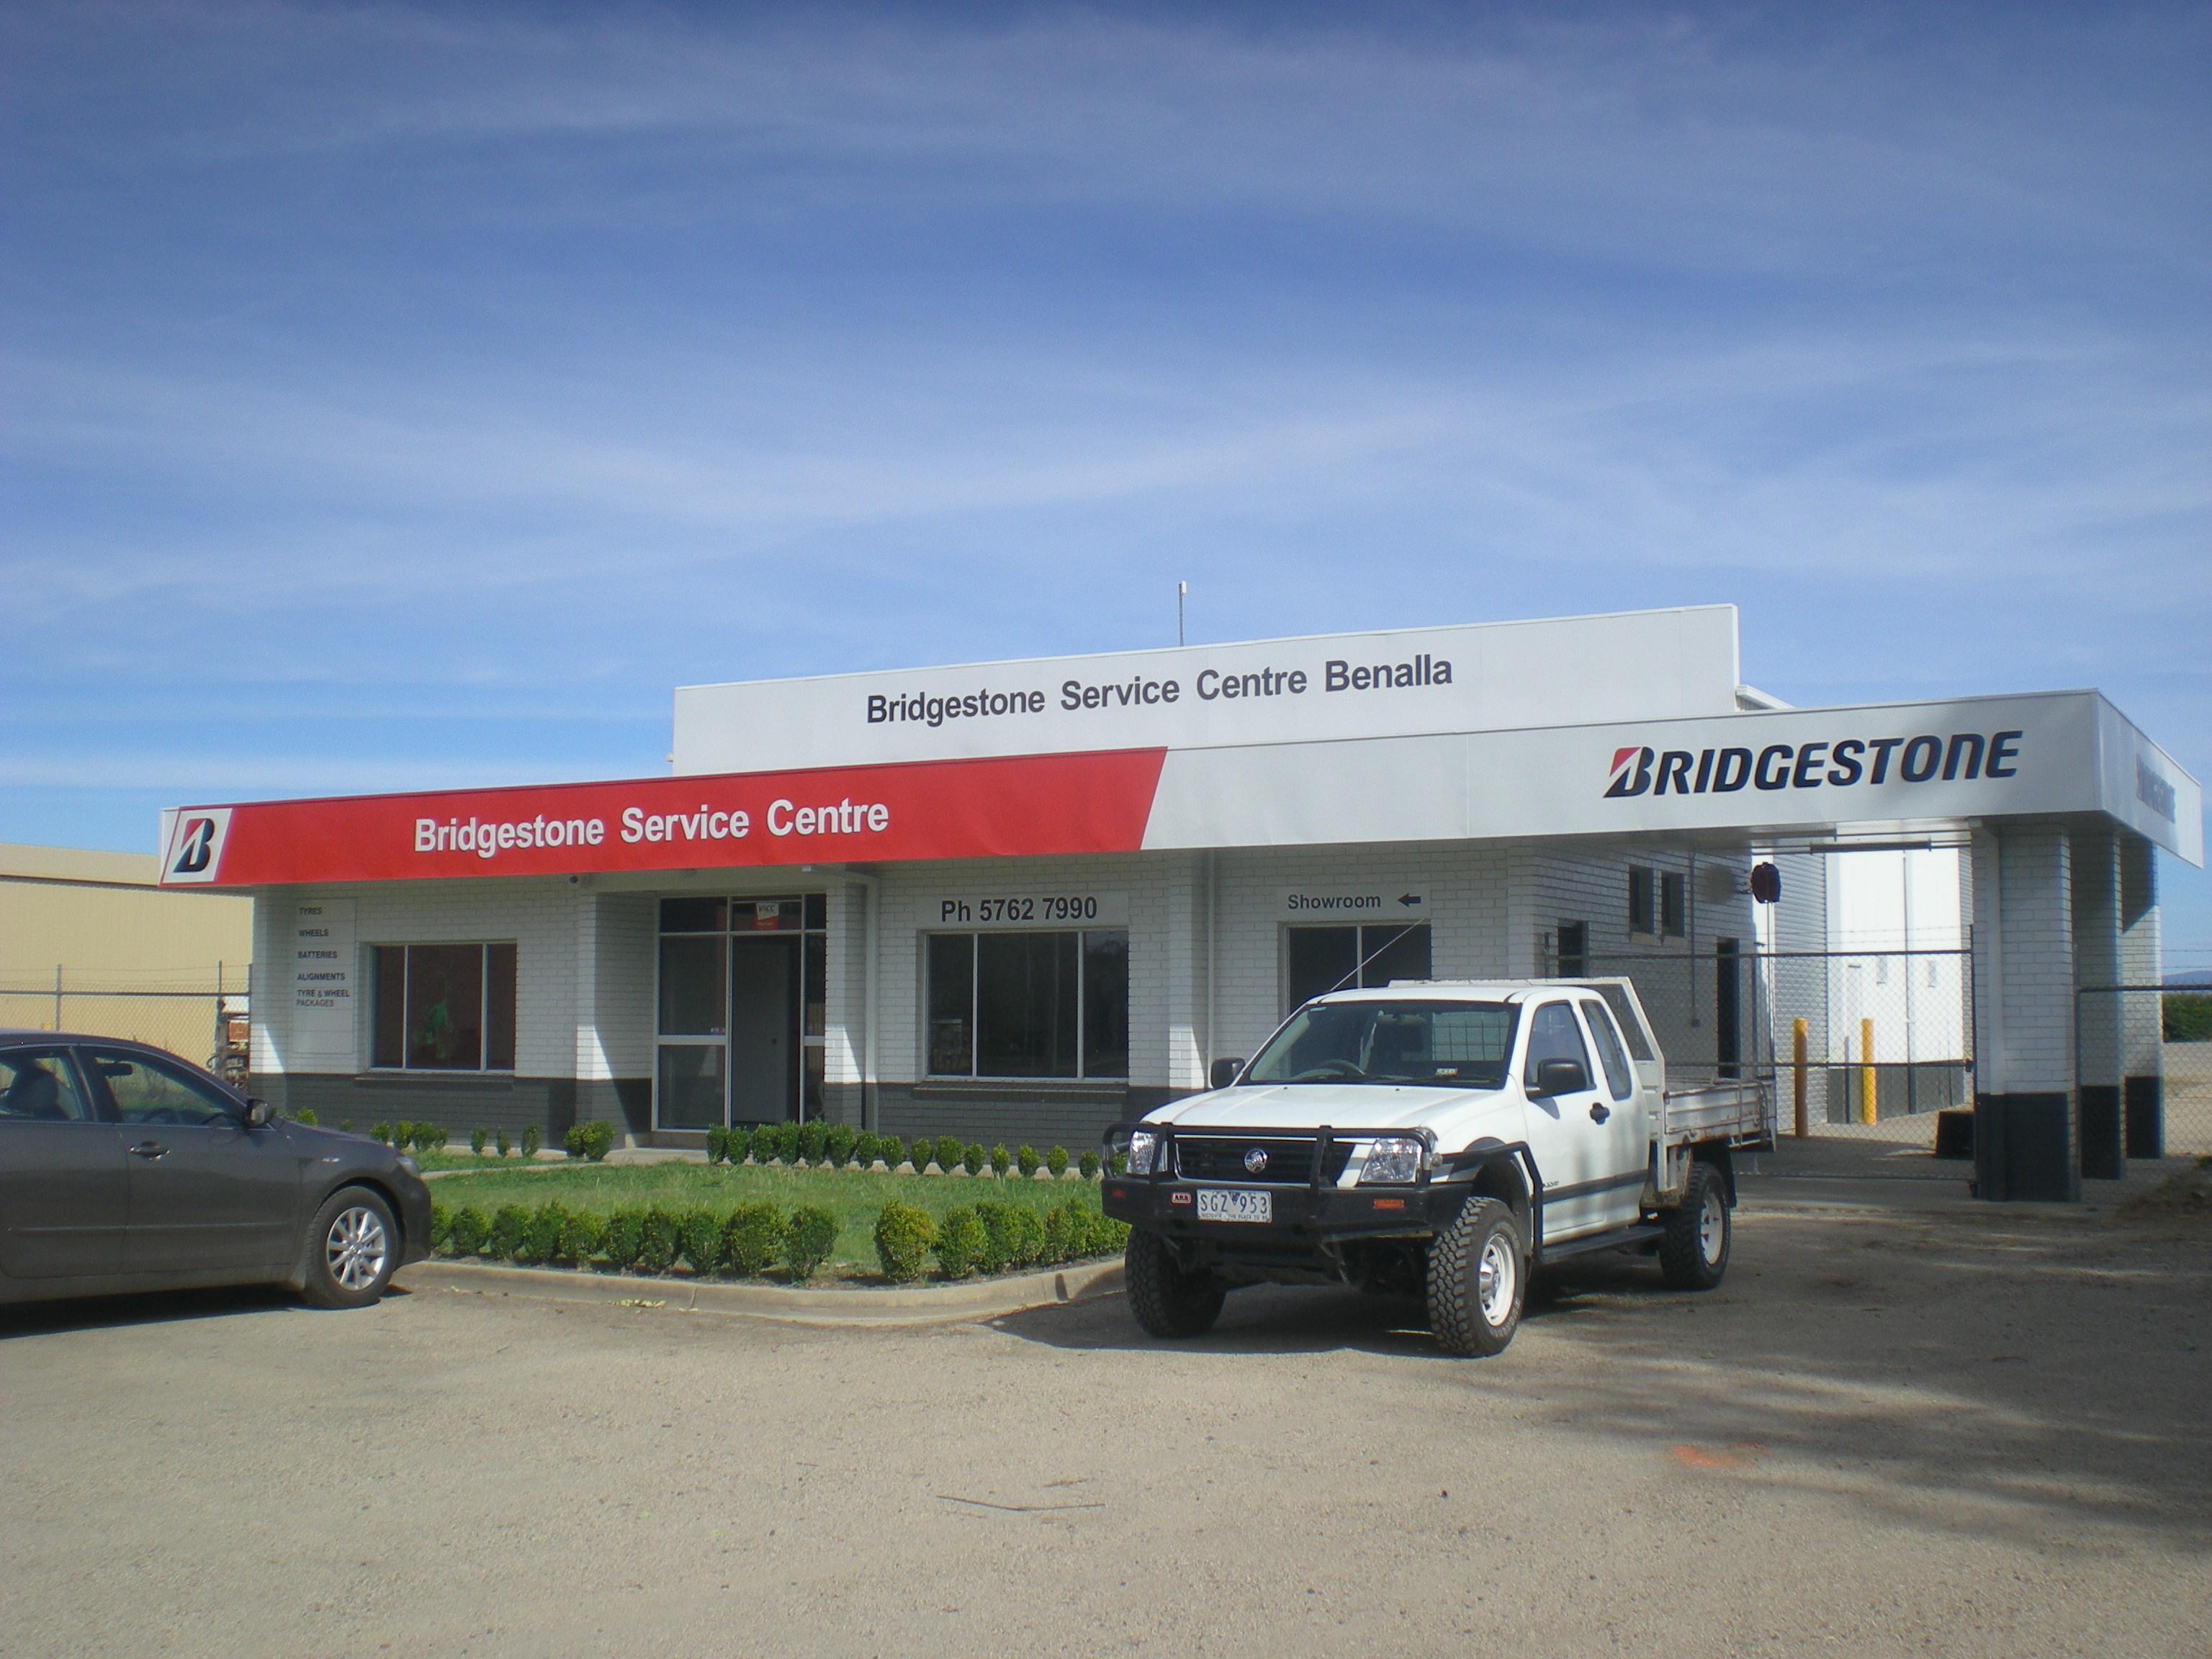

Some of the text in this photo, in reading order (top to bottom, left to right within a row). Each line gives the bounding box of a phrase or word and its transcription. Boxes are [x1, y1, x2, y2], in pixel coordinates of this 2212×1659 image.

[866, 654, 1453, 727] Bridgestone Service Centre Benalla
[1603, 729, 2023, 798] BRIDGESTONE
[415, 797, 889, 858] Bridgestone Service Centre
[1287, 894, 1381, 909] Showroom
[299, 907, 323, 915] TYRES
[941, 896, 1097, 922] Ph 5762 7990
[299, 928, 329, 937] WHEELS
[297, 950, 338, 959] BATTERIES
[297, 972, 346, 981] ALIGNMENTS
[297, 989, 316, 997] TYRE
[324, 989, 350, 997] WHEEL
[296, 999, 335, 1007] PACKAGES
